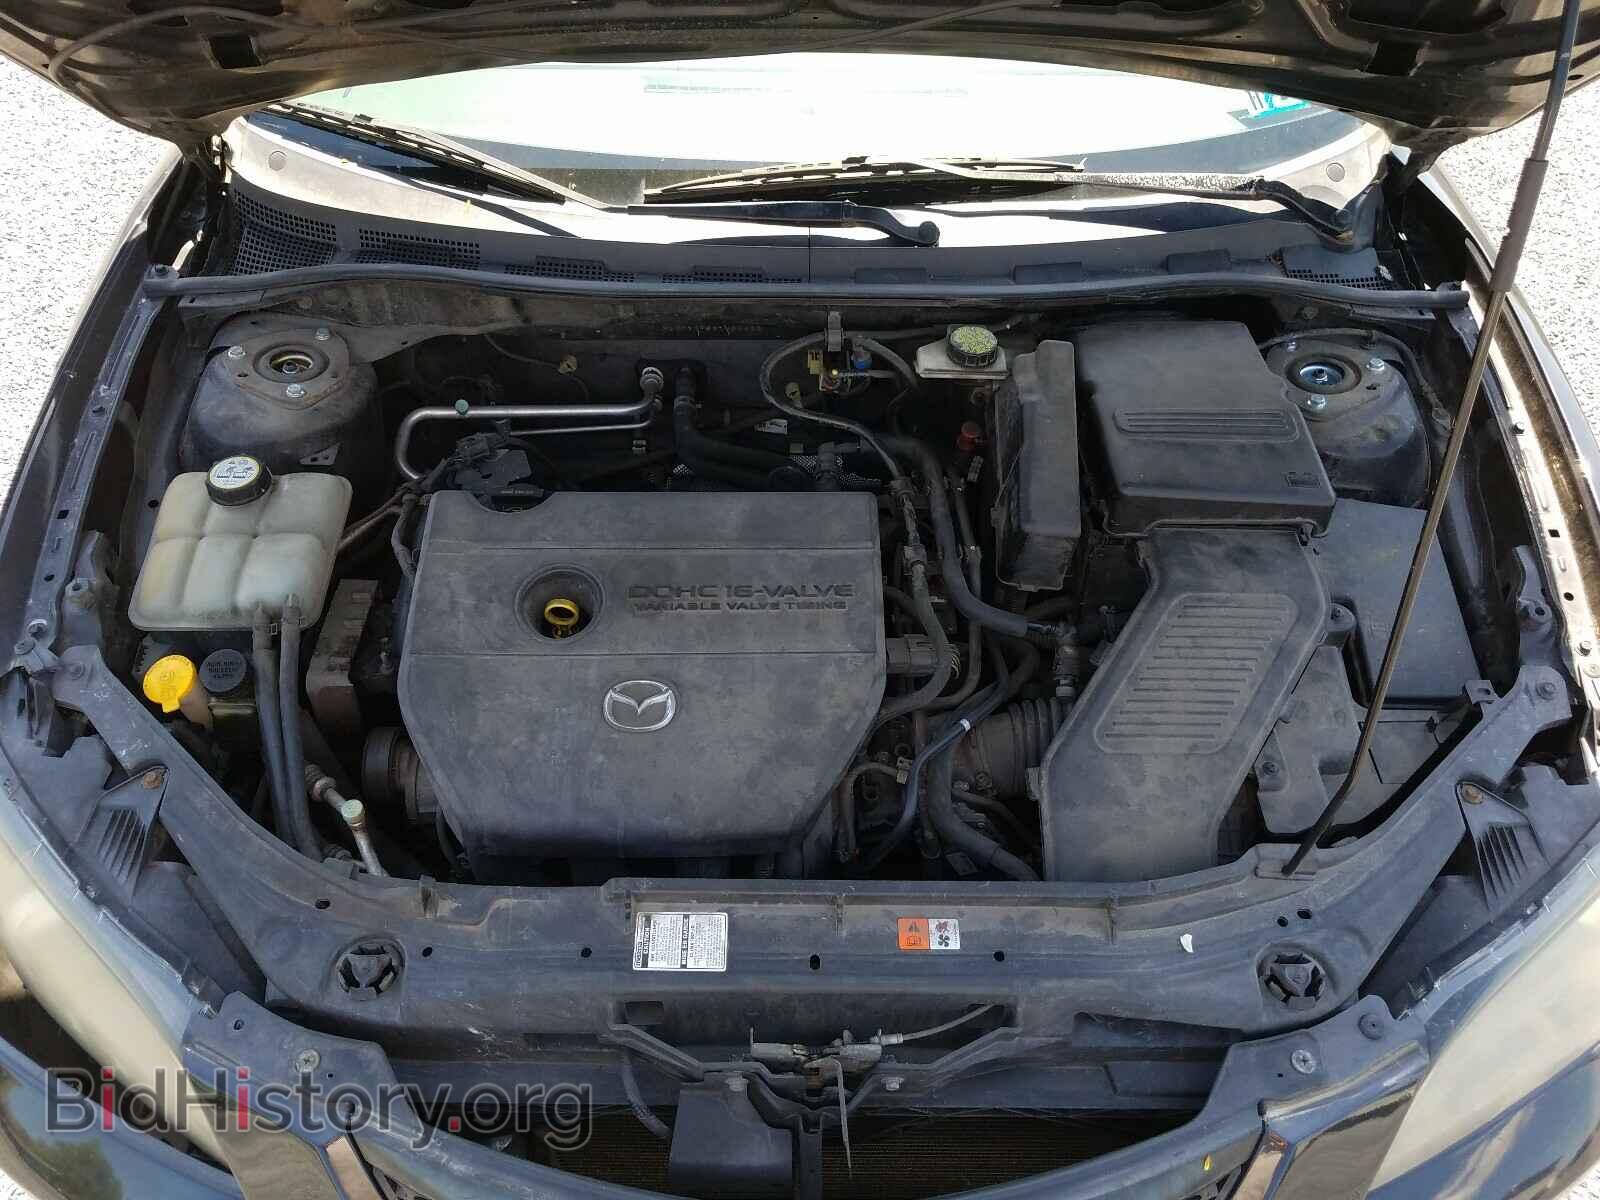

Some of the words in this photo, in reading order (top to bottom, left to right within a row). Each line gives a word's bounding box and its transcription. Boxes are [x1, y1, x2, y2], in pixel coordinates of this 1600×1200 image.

[628, 585, 719, 598] DOHC
[725, 584, 855, 598] 16-VALVE
[726, 601, 780, 611] VALVE
